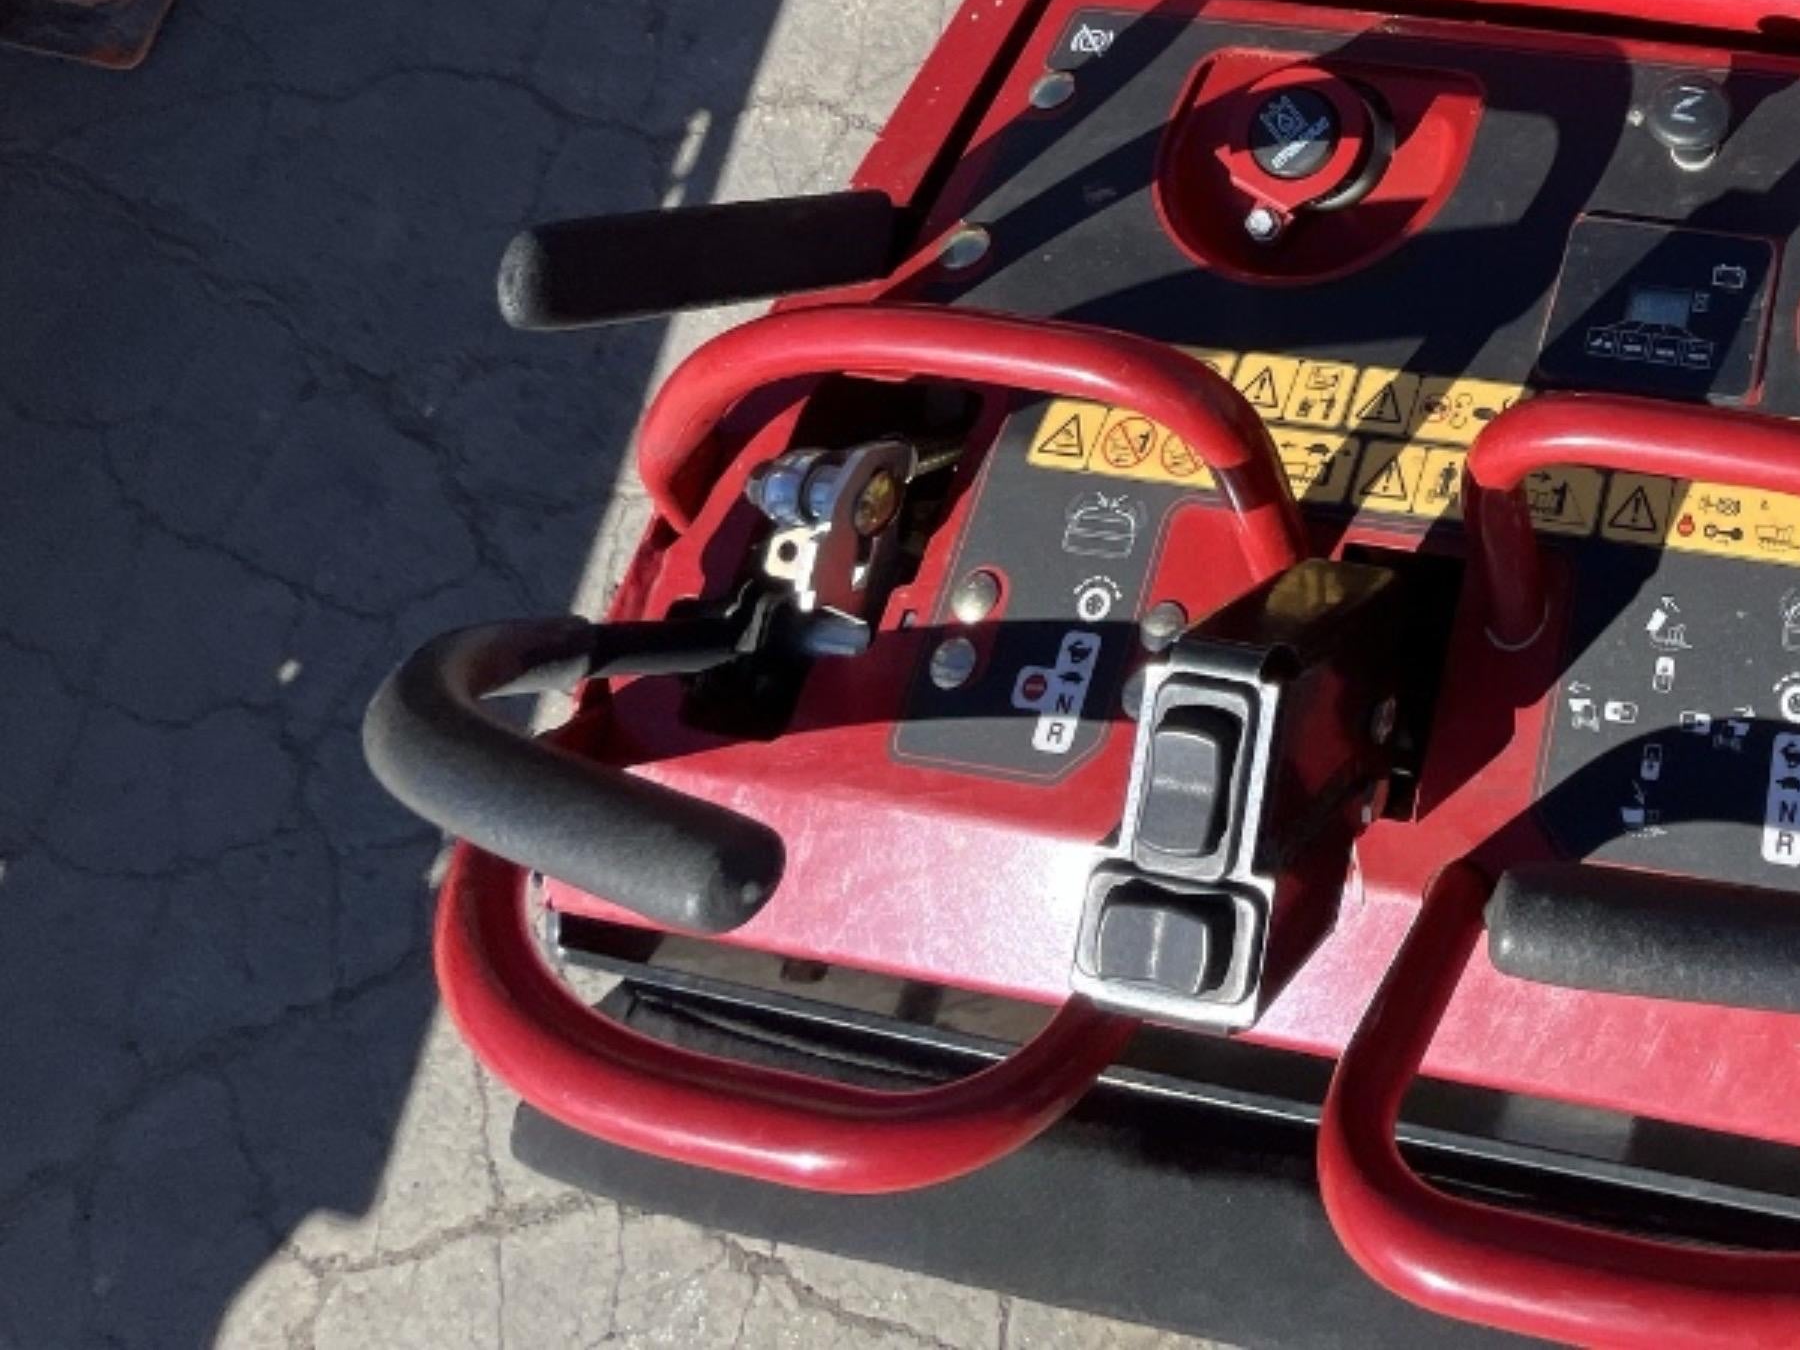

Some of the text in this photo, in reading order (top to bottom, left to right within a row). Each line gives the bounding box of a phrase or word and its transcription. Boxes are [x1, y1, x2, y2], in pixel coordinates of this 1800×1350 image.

[1055, 692, 1075, 715] N
[1046, 721, 1066, 745] R
[1778, 799, 1798, 824] N
[1775, 831, 1794, 857] R
